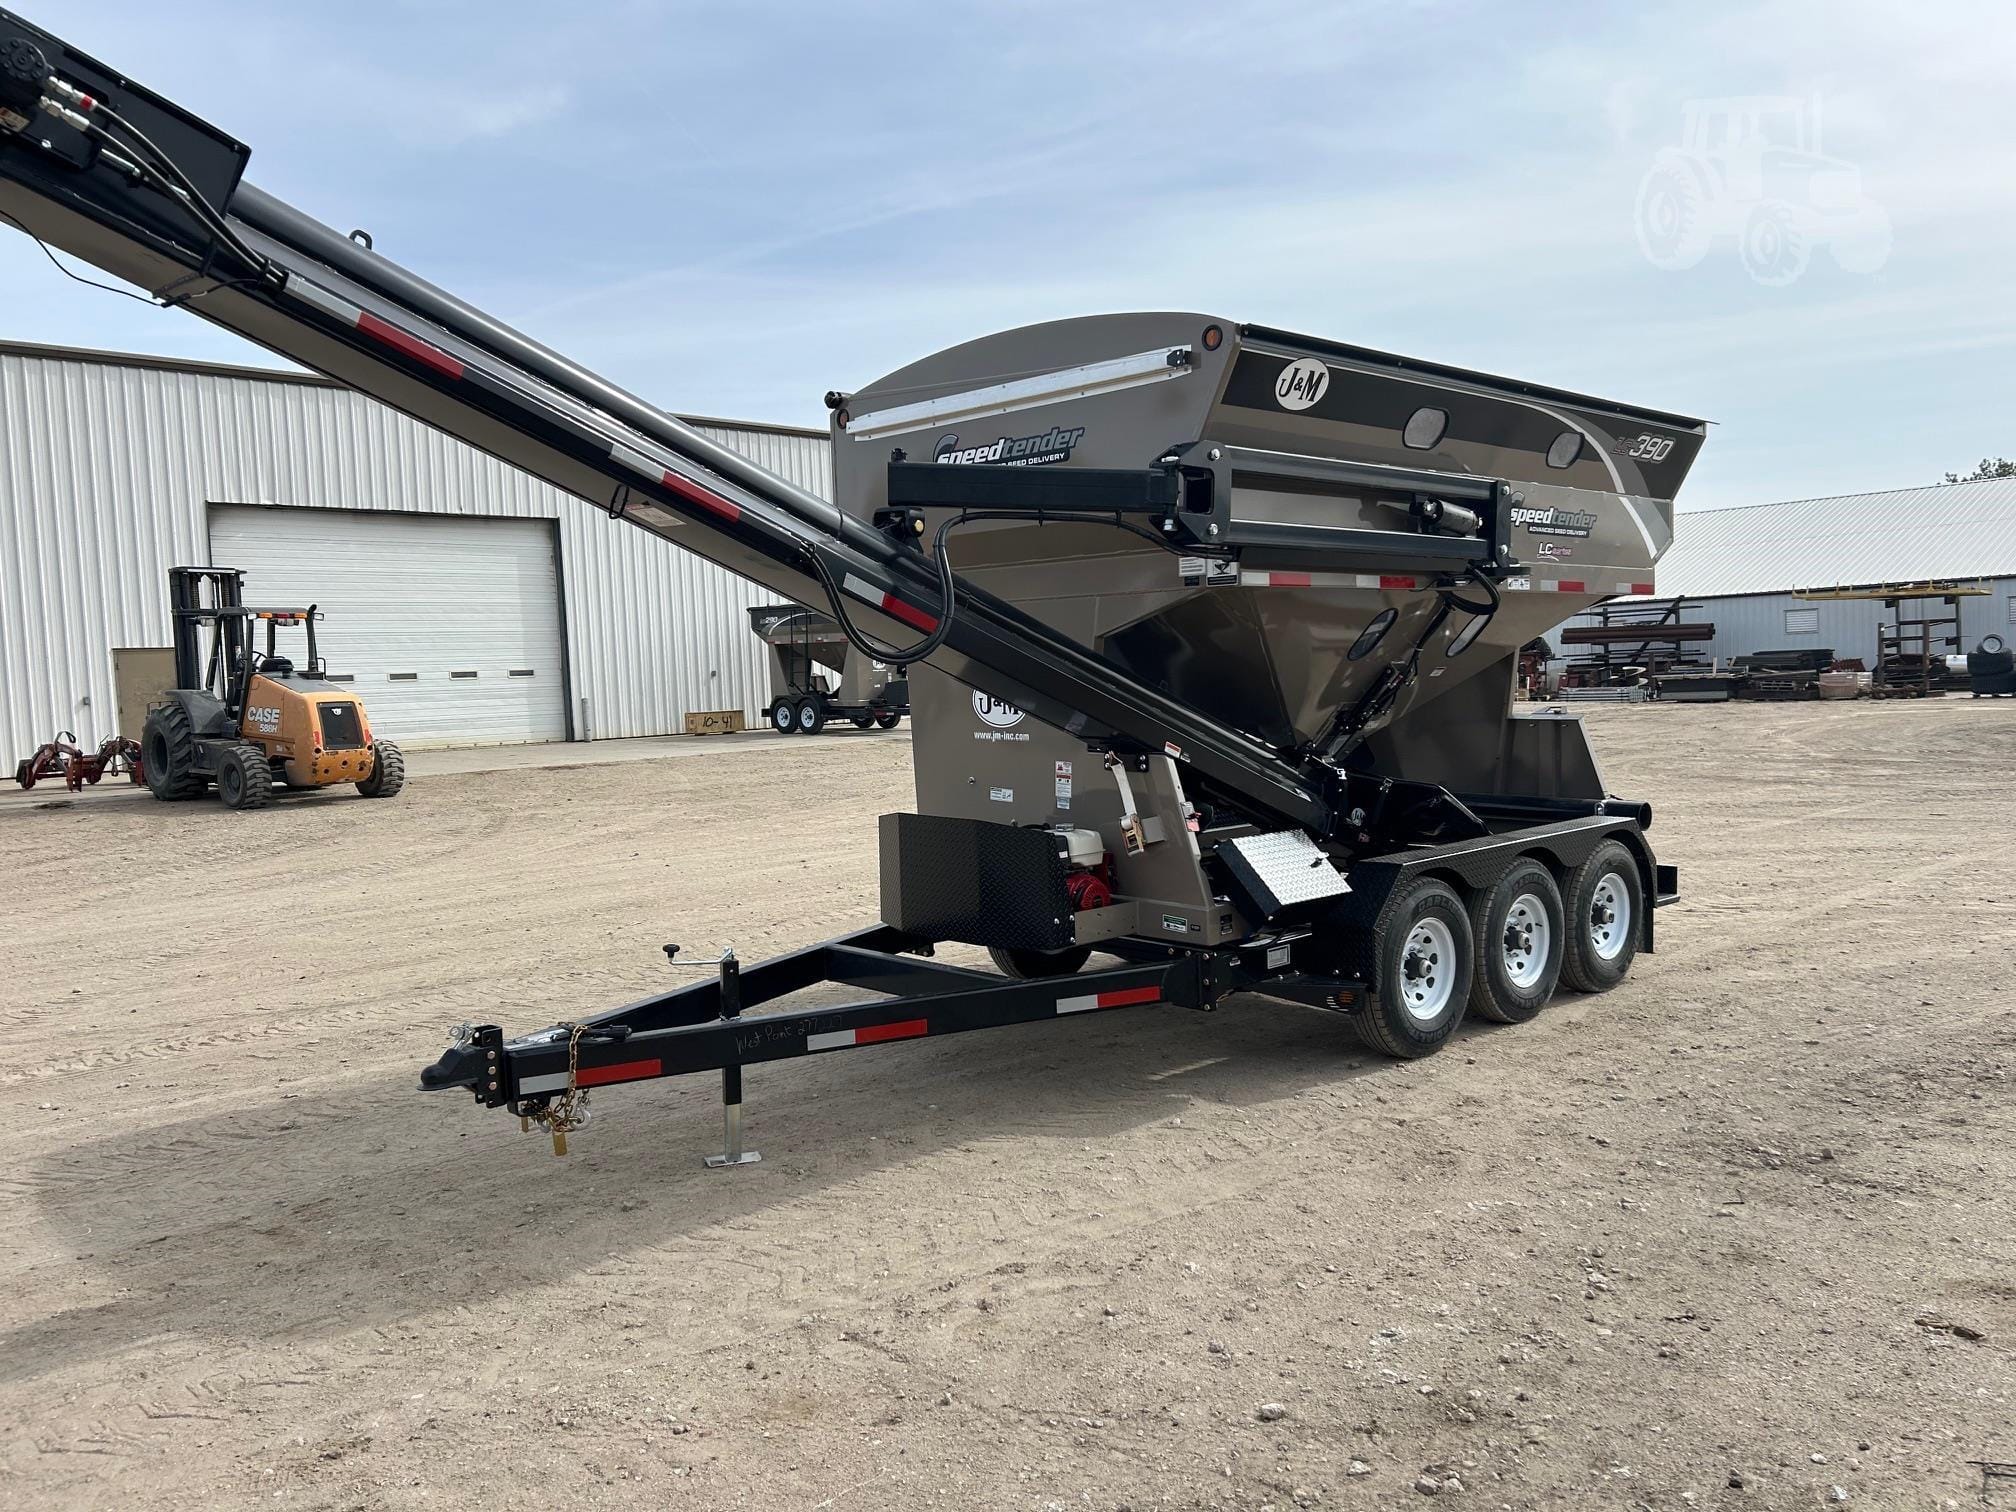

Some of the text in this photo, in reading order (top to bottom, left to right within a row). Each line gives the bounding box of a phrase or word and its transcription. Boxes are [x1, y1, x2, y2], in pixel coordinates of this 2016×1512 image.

[1278, 367, 1326, 402] J&M
[1028, 453, 1065, 465] DELIVERY
[247, 706, 281, 723] CASE
[973, 730, 1030, 742] www.jm-inc.com
